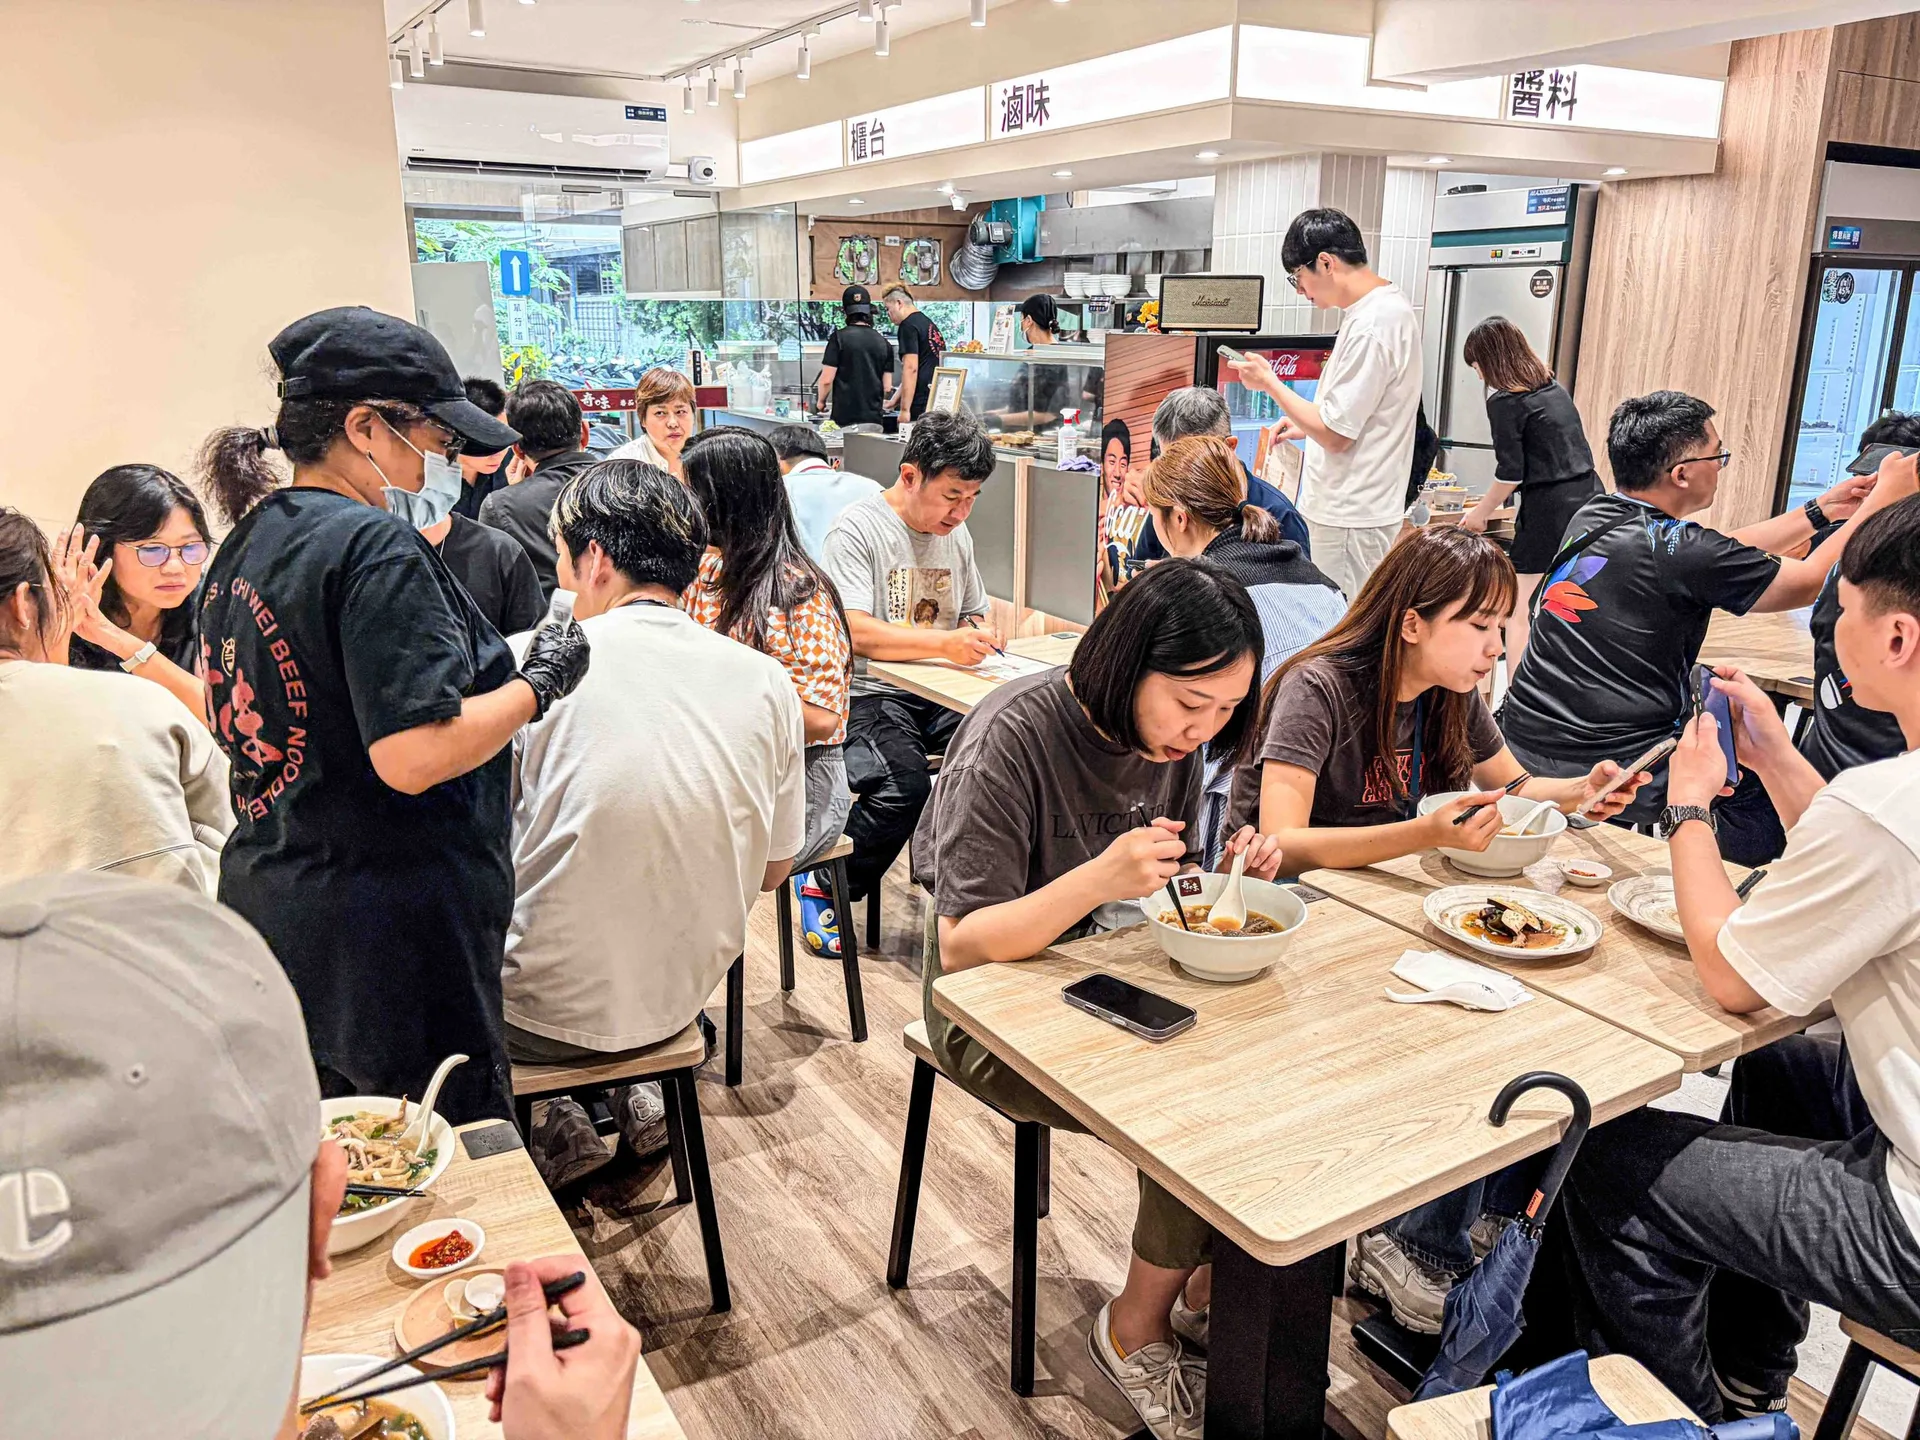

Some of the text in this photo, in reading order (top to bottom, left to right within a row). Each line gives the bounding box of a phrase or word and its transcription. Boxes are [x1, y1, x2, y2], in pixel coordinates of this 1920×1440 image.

[1001, 79, 1050, 132] 滷味
[1512, 69, 1577, 120] 醬料
[851, 118, 885, 161] 櫃台
[1191, 295, 1230, 307] Marshall
[580, 392, 611, 410] 奇味
[249, 588, 279, 637] WEI
[269, 638, 308, 720] BEEF
